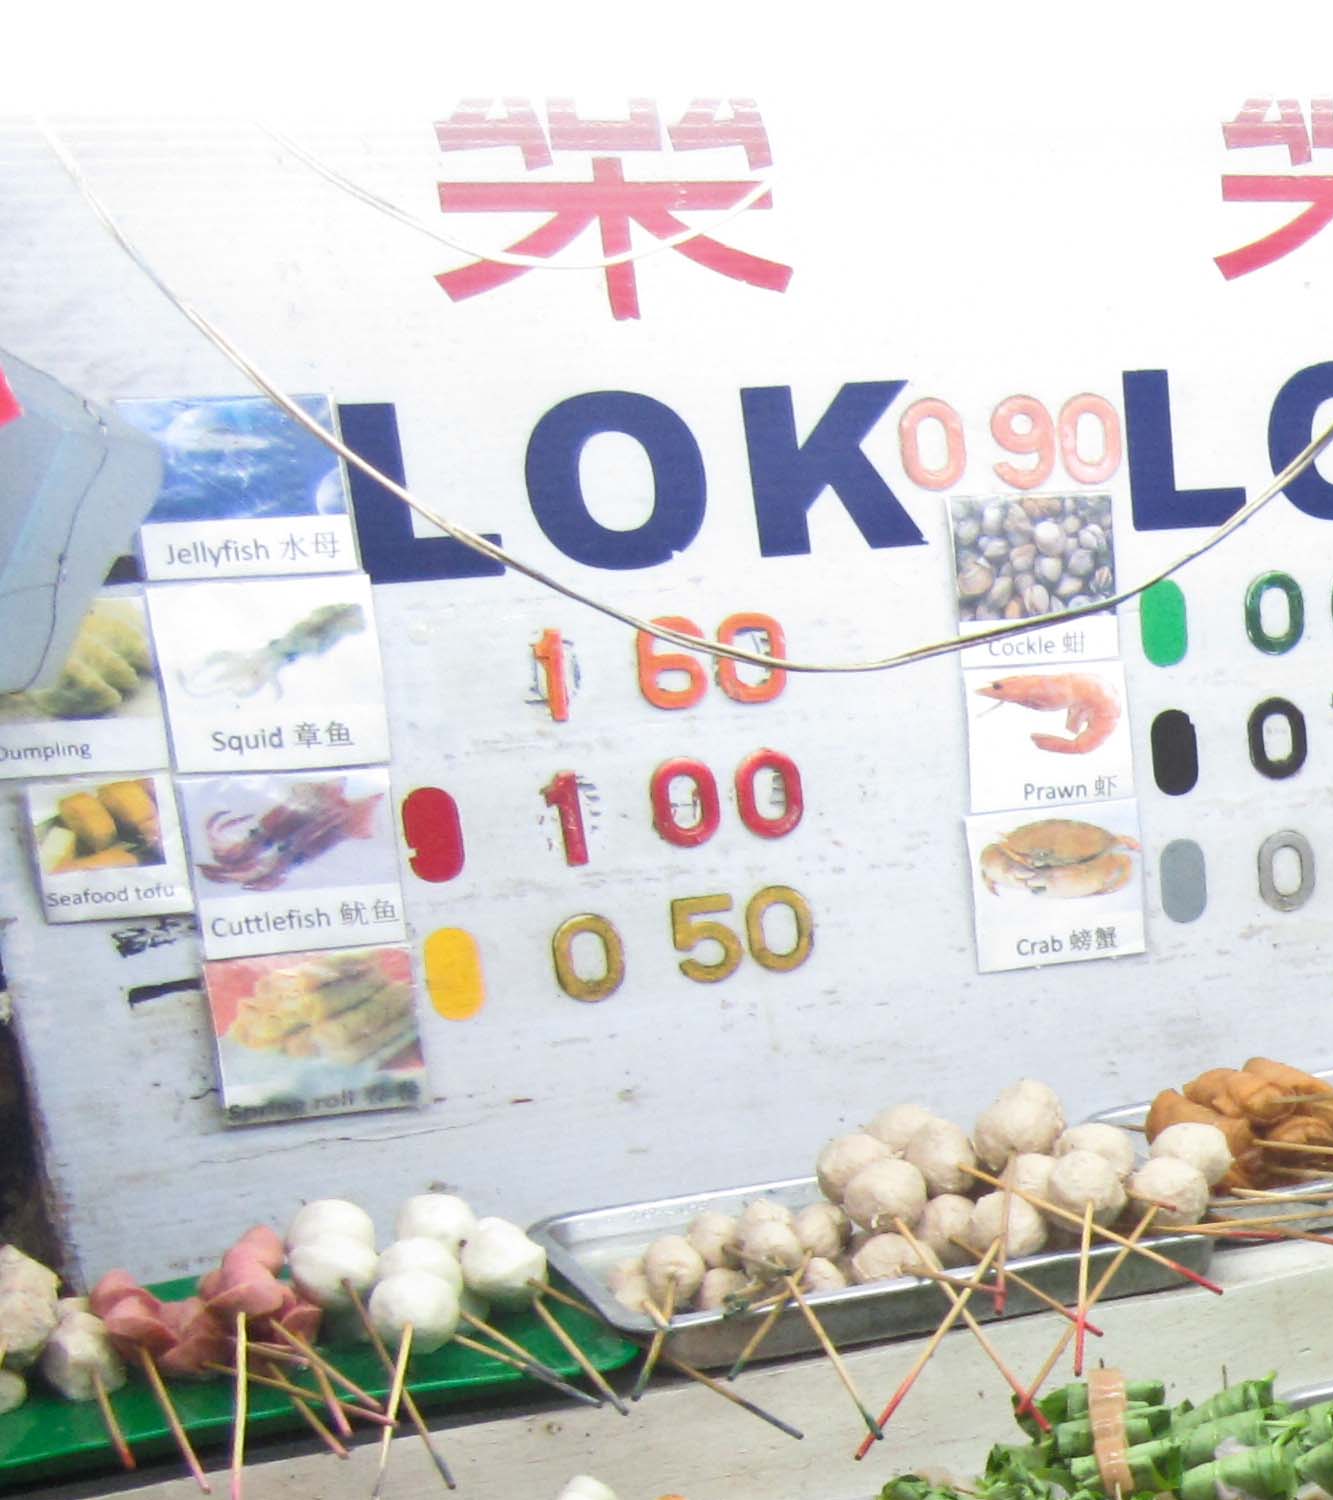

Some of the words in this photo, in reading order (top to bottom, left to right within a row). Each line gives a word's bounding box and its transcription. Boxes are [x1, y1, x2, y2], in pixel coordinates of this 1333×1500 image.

[337, 380, 928, 584] LOK
[167, 539, 270, 568] Jellyfish
[279, 531, 341, 561] 水母
[988, 634, 1056, 657] Cockle
[211, 727, 285, 756] Squid
[294, 720, 356, 749] 章鱼
[1024, 782, 1088, 801] Prawn
[1094, 775, 1118, 799] 虾
[46, 885, 129, 908] Seafood
[134, 882, 175, 900] tofu
[211, 907, 332, 938] Cuttlefish
[340, 898, 401, 926] 鱿鱼
[1017, 935, 1063, 957] Crab
